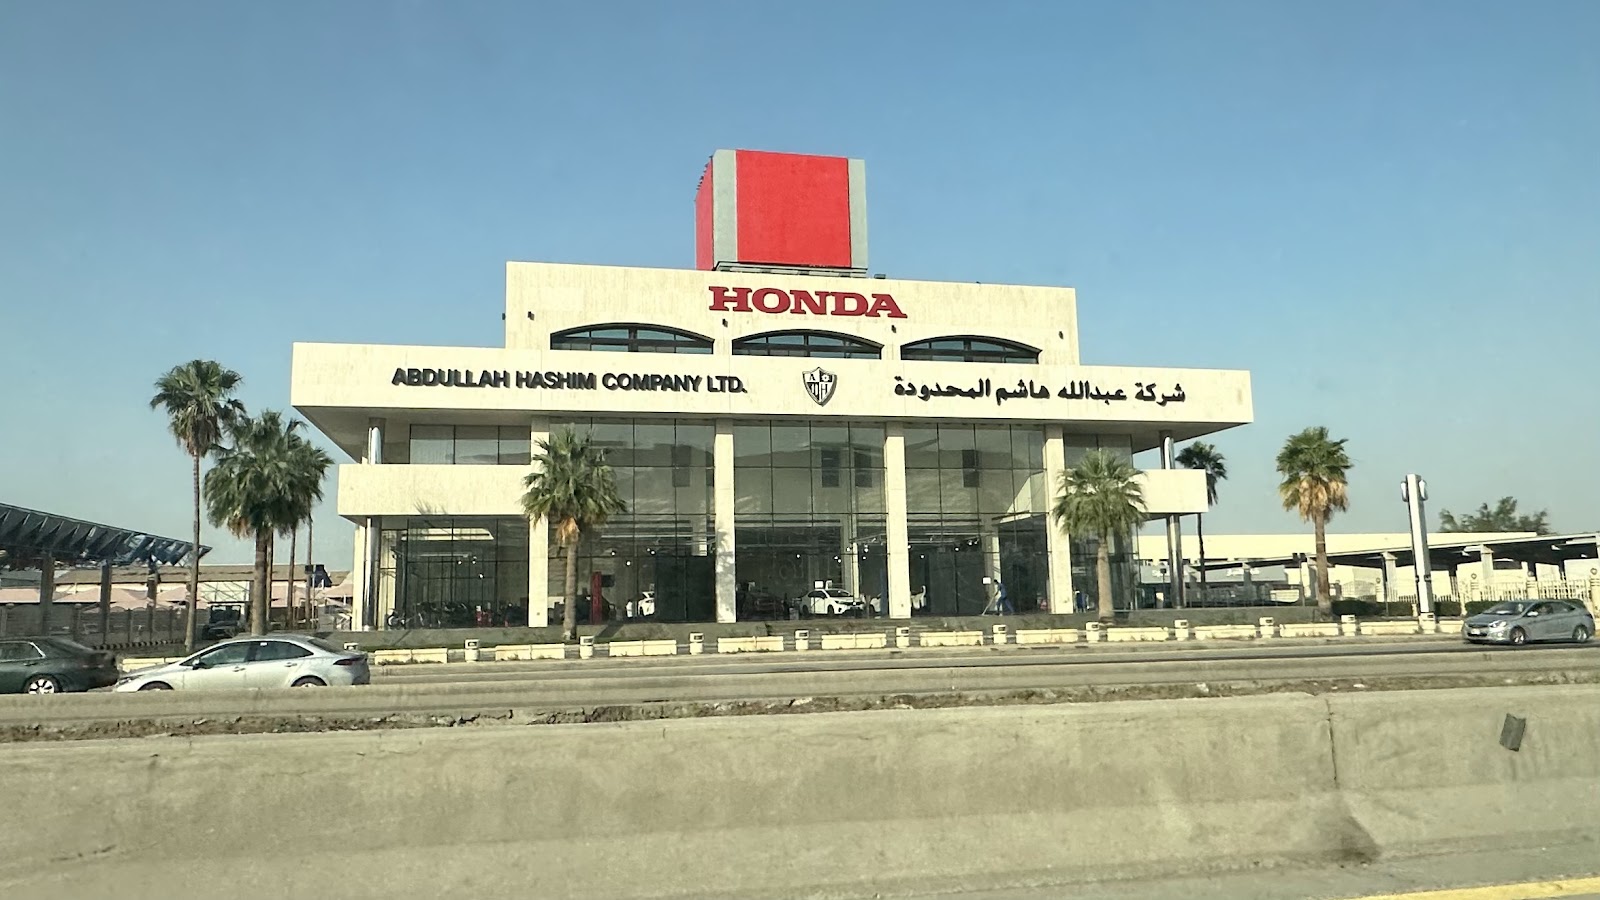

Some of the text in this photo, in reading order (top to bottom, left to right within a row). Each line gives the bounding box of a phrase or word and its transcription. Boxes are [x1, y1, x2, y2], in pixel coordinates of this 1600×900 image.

[708, 286, 907, 319] HONDA
[391, 367, 748, 394] ABDULLAH HASHIM COMPANY LTD.
[893, 375, 991, 402] المحدودة
[995, 379, 1051, 406] هاشم
[1134, 382, 1186, 407] شركة
